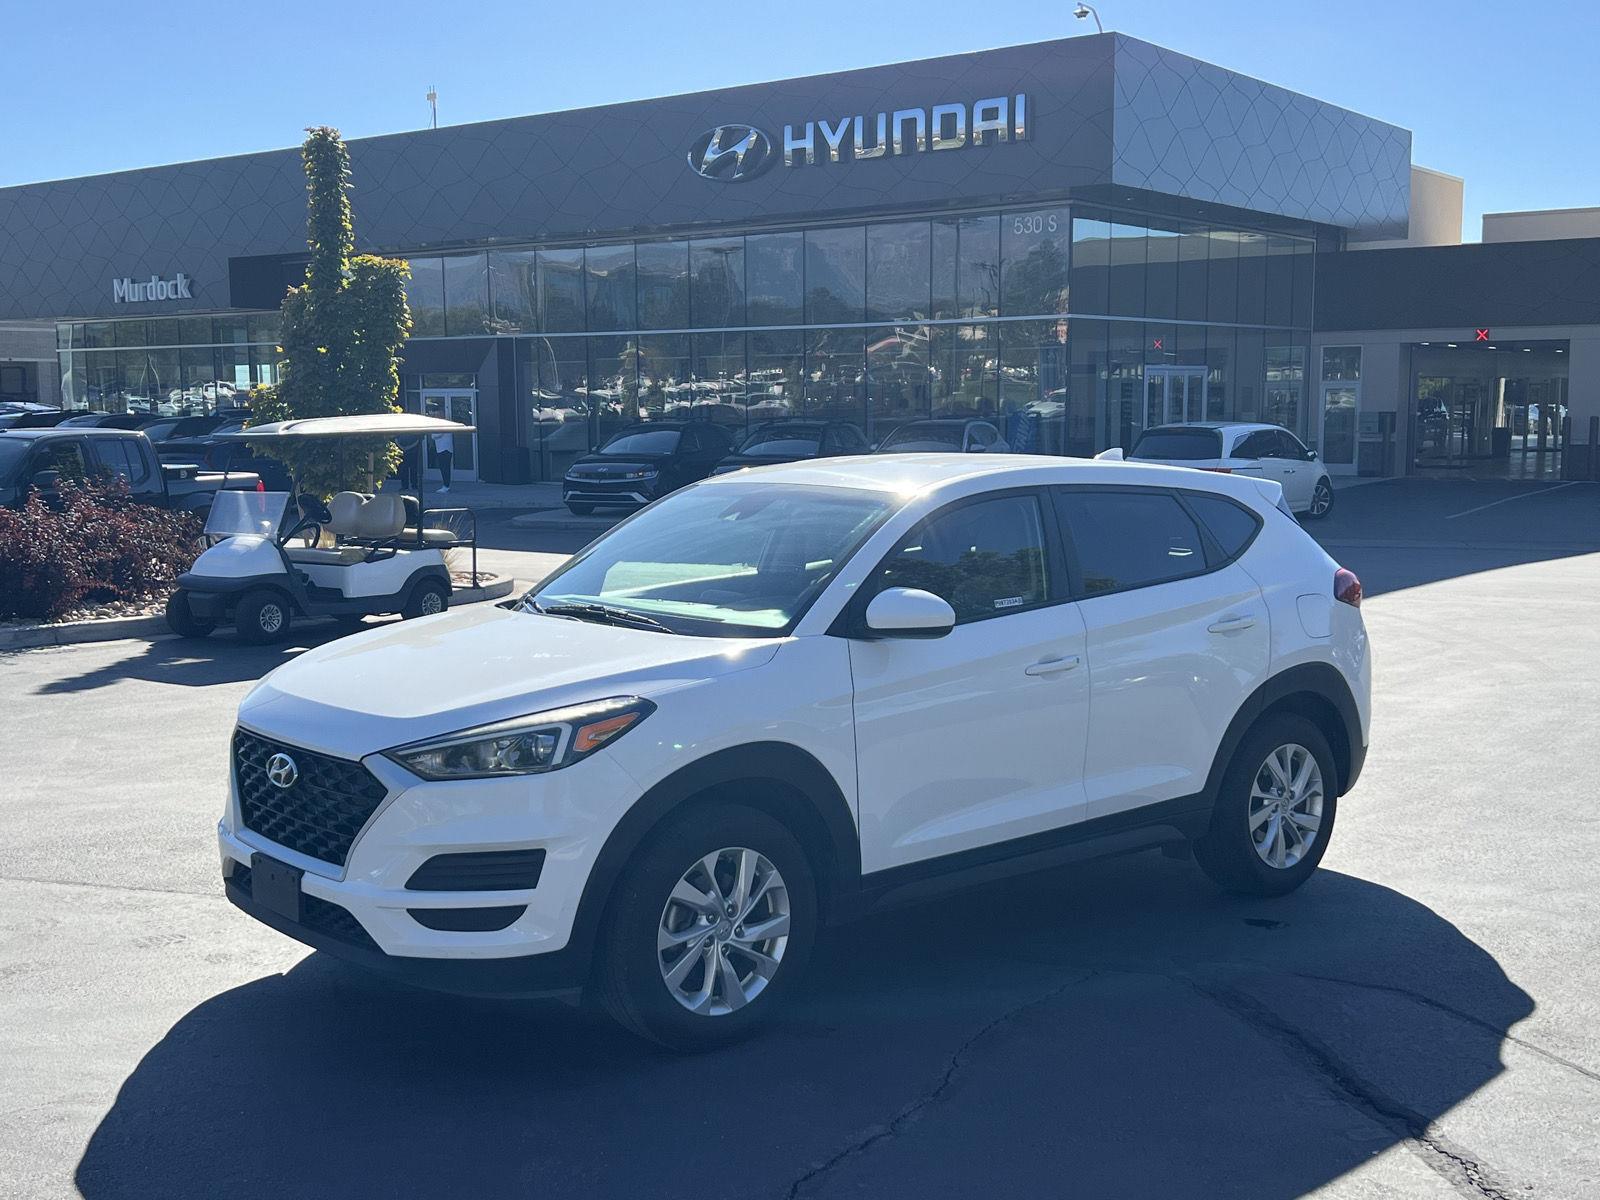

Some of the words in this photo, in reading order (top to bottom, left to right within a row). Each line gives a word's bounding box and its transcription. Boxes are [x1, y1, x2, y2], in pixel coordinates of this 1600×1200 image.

[783, 93, 1028, 167] HYUNDAI
[1014, 216, 1043, 235] 530
[1048, 214, 1058, 232] S
[113, 273, 192, 303] Murdock
